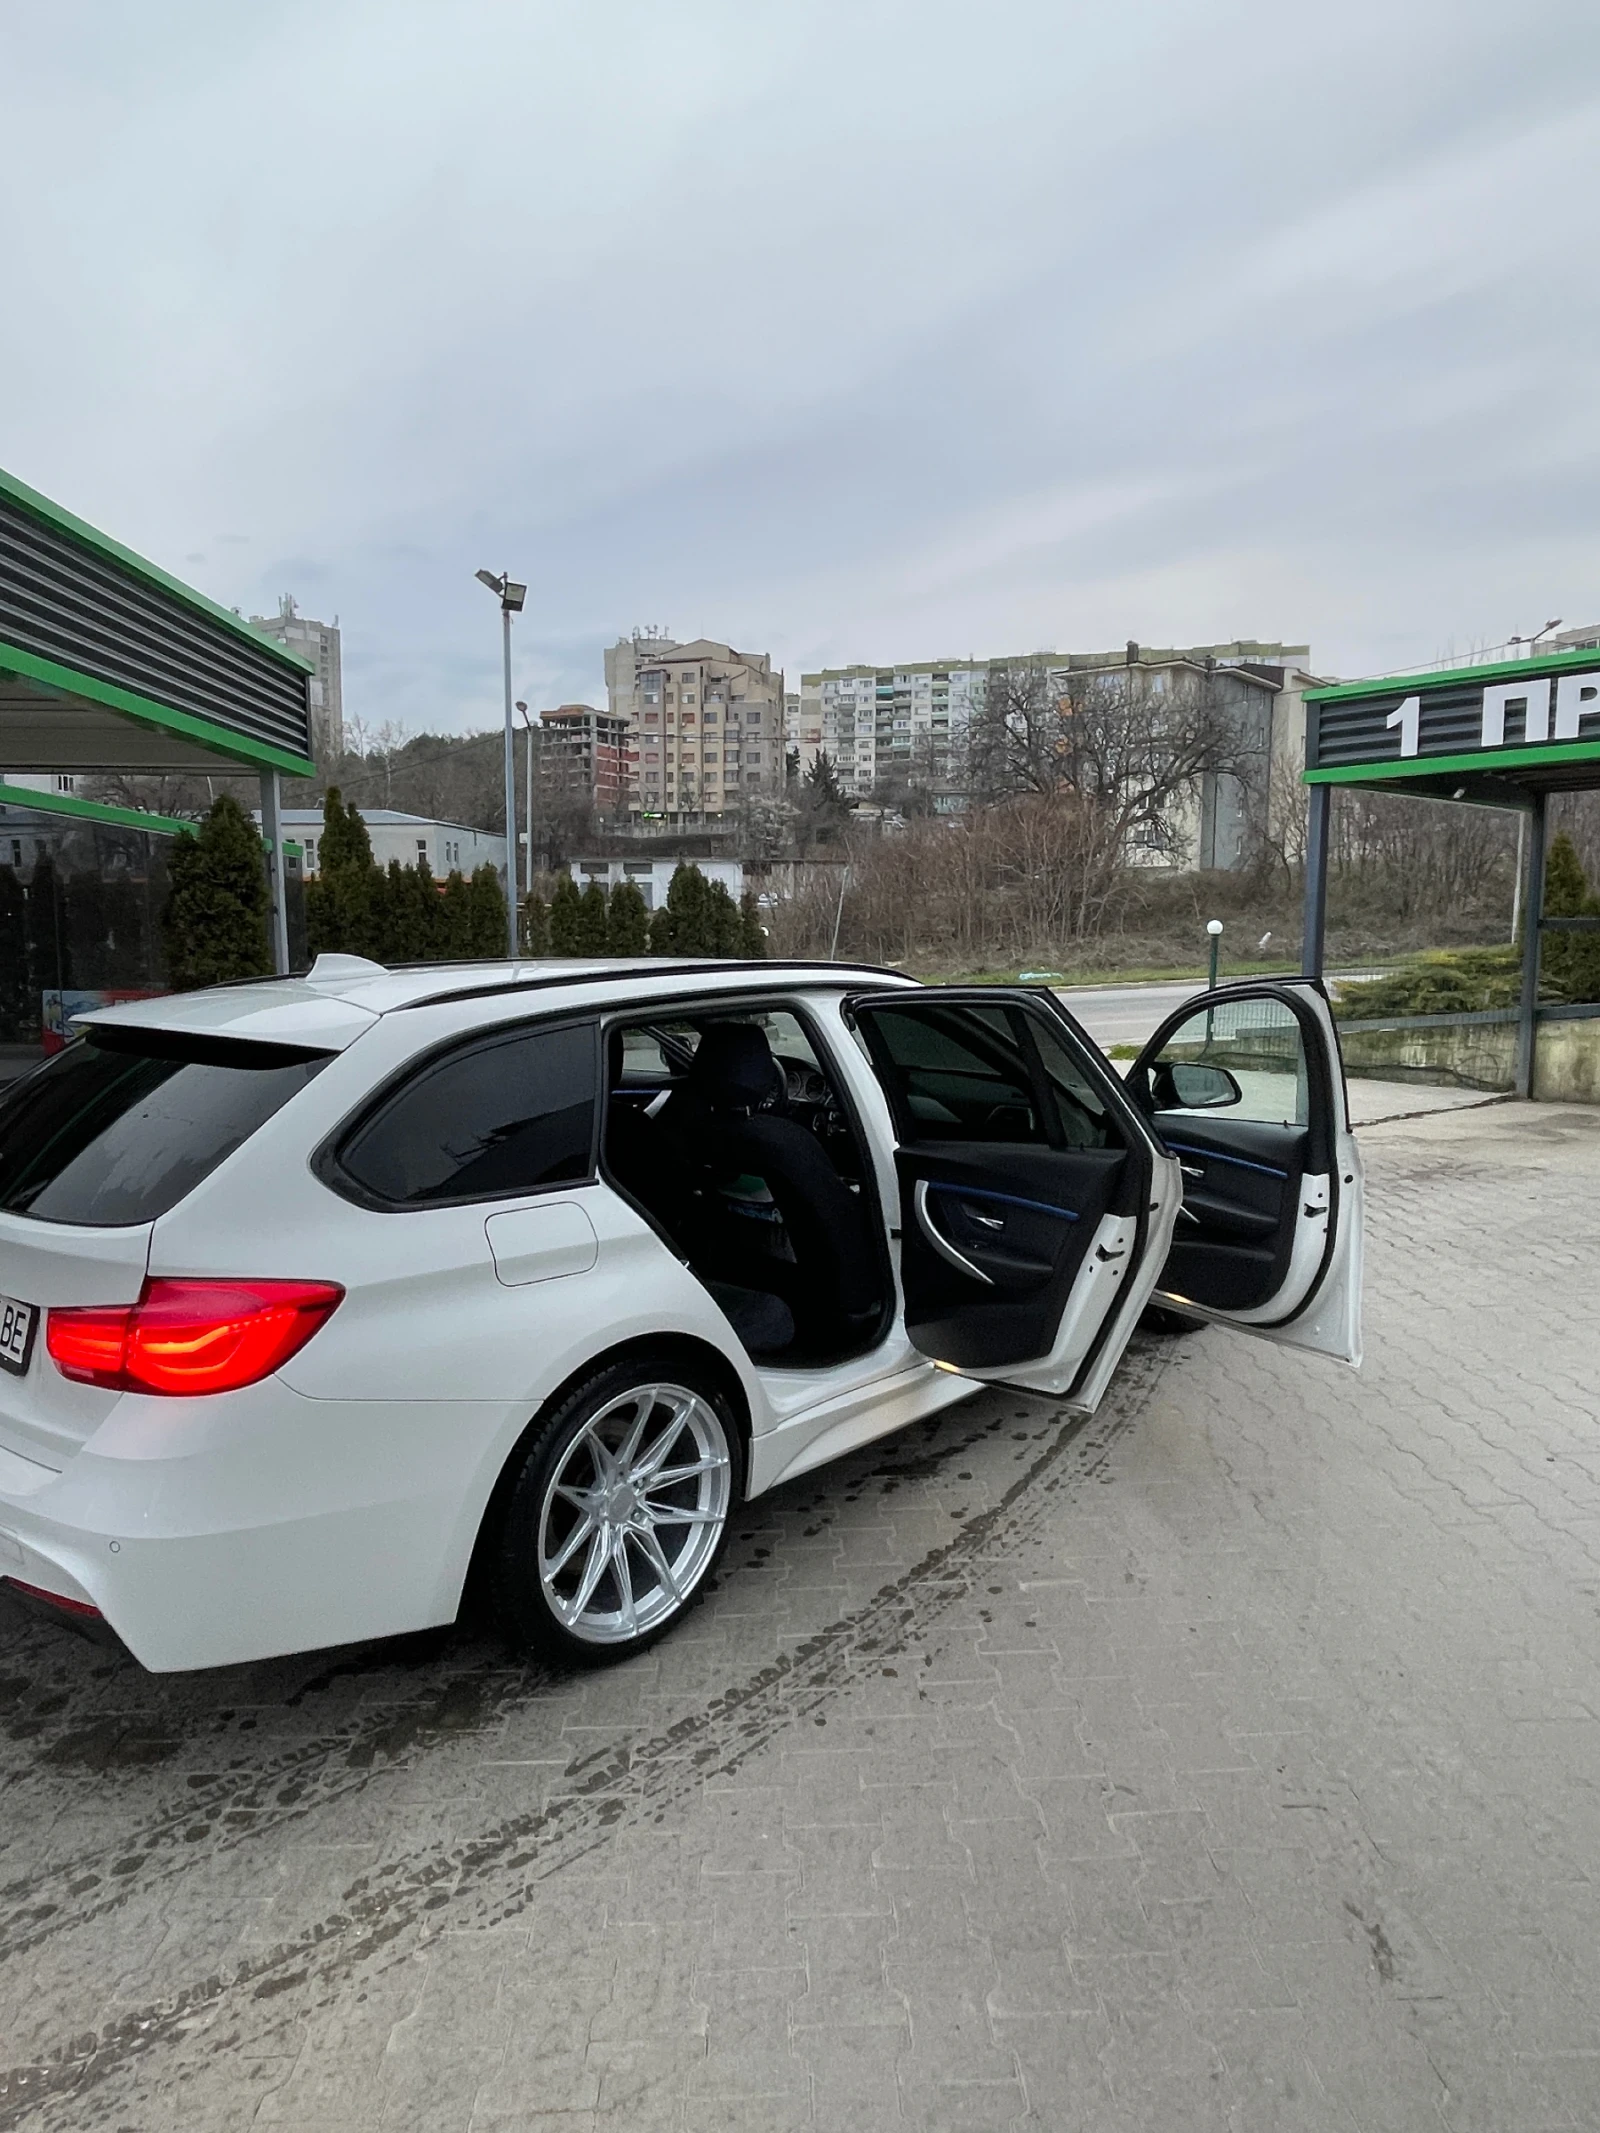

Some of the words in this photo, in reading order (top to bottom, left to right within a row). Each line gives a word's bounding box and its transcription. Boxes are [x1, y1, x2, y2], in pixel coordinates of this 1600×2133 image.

[1386, 696, 1420, 757] 1
[1481, 672, 1600, 747] ПР
[0, 1305, 26, 1354] BE
